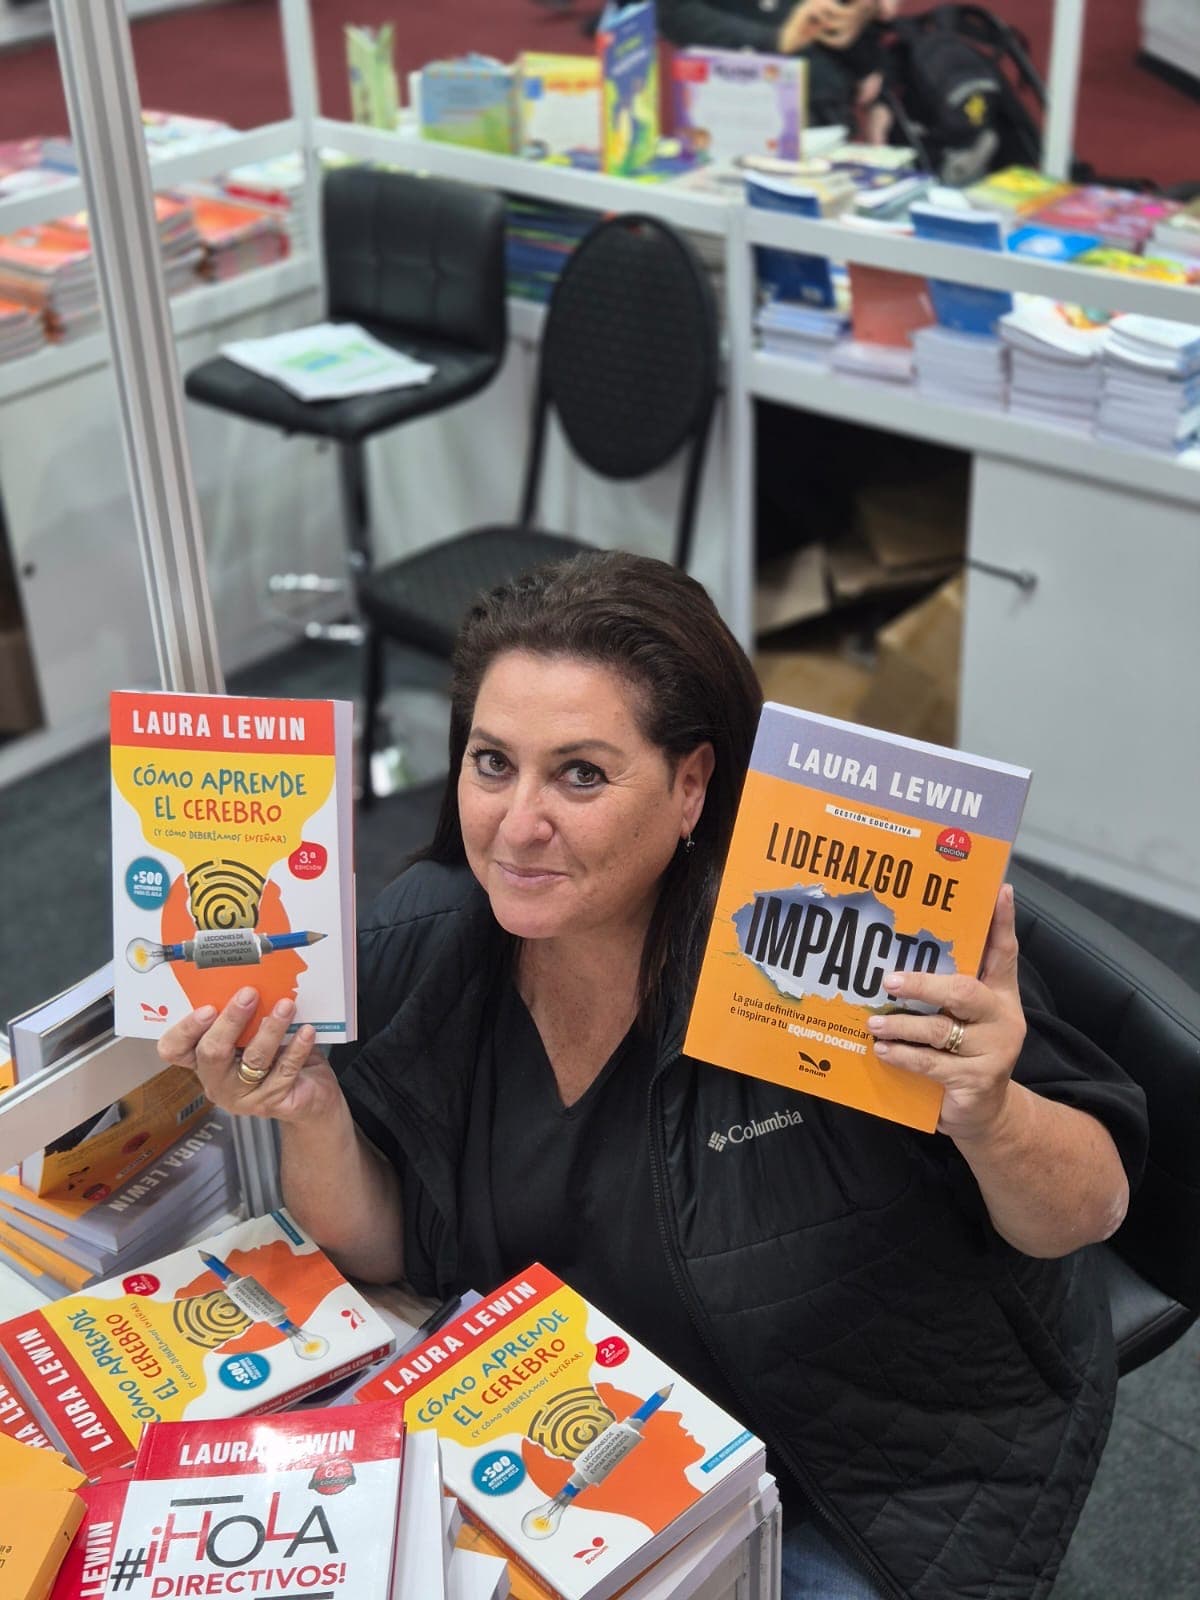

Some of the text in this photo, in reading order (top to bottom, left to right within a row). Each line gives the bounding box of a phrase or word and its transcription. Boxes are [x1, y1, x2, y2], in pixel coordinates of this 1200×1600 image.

[132, 710, 306, 741] LAURA LEWIN
[133, 764, 307, 798] CÓMO APRENDE
[788, 742, 983, 818] LAURA LEWIN
[154, 795, 282, 825] EL CEREBRO
[834, 808, 867, 823] GESTIÓN
[868, 818, 912, 836] EDUCATIVA
[766, 822, 960, 912] LIDERAZGO DE
[940, 846, 966, 858] EDICIÓN
[132, 870, 163, 886] +500
[733, 992, 870, 1040] La guía definitiva para potenciar
[737, 1007, 770, 1023] inspirar
[771, 1018, 777, 1026] a
[778, 1019, 788, 1030] tu
[788, 1024, 824, 1042] EQUIPO
[824, 1034, 868, 1055] DOCENTE
[798, 1064, 826, 1078] Bonum
[164, 1121, 224, 1168] LAURA
[727, 1108, 804, 1144] Columbia
[108, 1169, 169, 1212] LEWIN
[67, 1309, 128, 1376] APRENDE
[106, 1314, 180, 1400] EL CEREBRO
[383, 1280, 538, 1396] LAURA LEWIN
[226, 1362, 250, 1384] +500
[417, 1309, 569, 1424] CÓMO APRENDE
[452, 1338, 566, 1427] EL CEREBRO
[16, 1327, 114, 1452] LAURA LEWIN
[180, 1440, 266, 1466] LAURA
[481, 1456, 511, 1482] +500
[80, 1520, 114, 1598] LEWIN
[152, 1562, 346, 1599] DIRECTIVOS!
